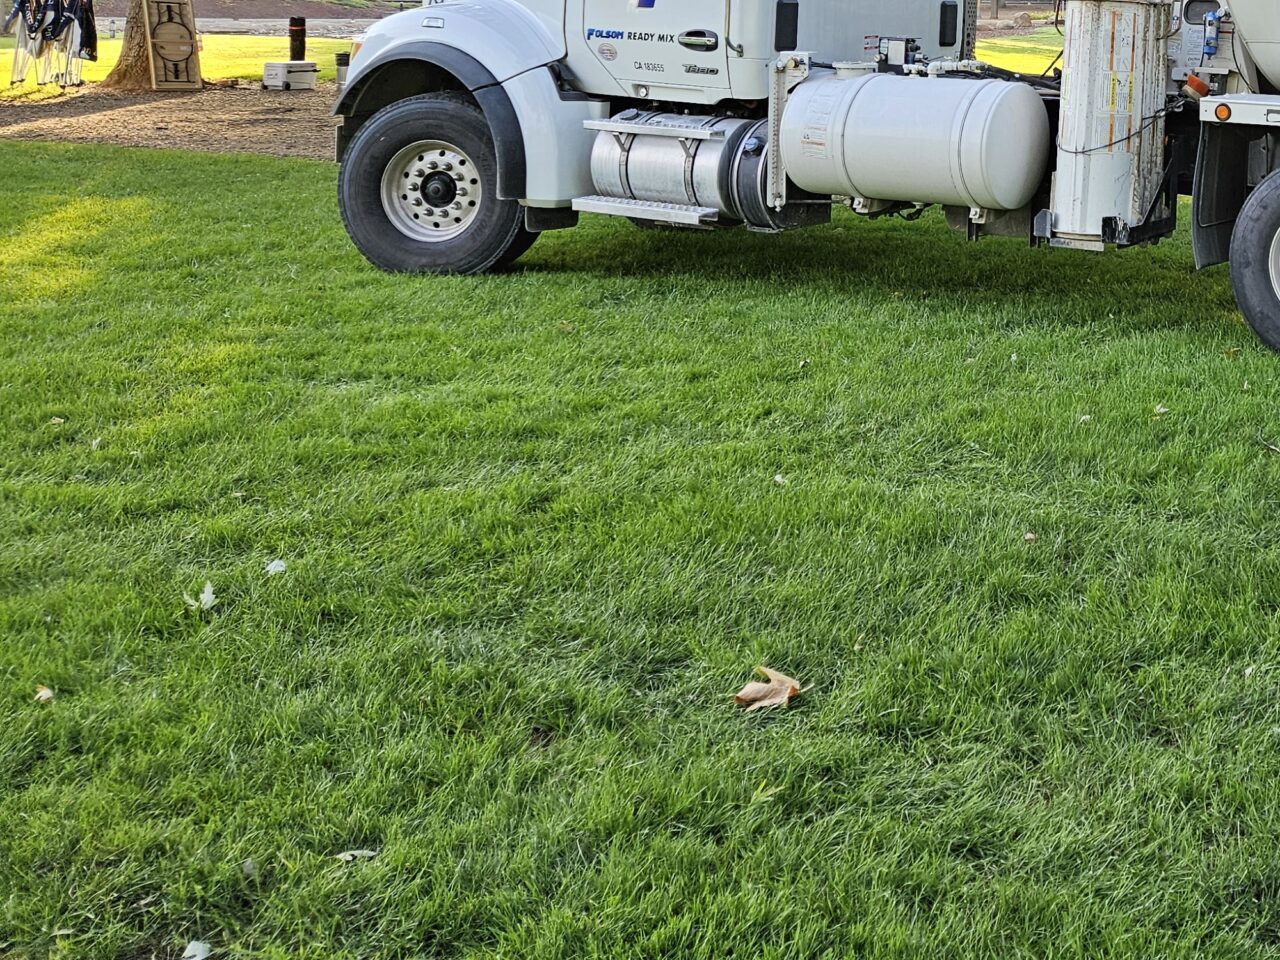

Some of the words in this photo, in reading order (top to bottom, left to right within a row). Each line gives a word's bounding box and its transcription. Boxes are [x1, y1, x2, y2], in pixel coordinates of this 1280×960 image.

[587, 28, 625, 40] FOLSOM
[627, 31, 655, 41] READY
[657, 34, 675, 43] MIX
[633, 61, 643, 70] CA
